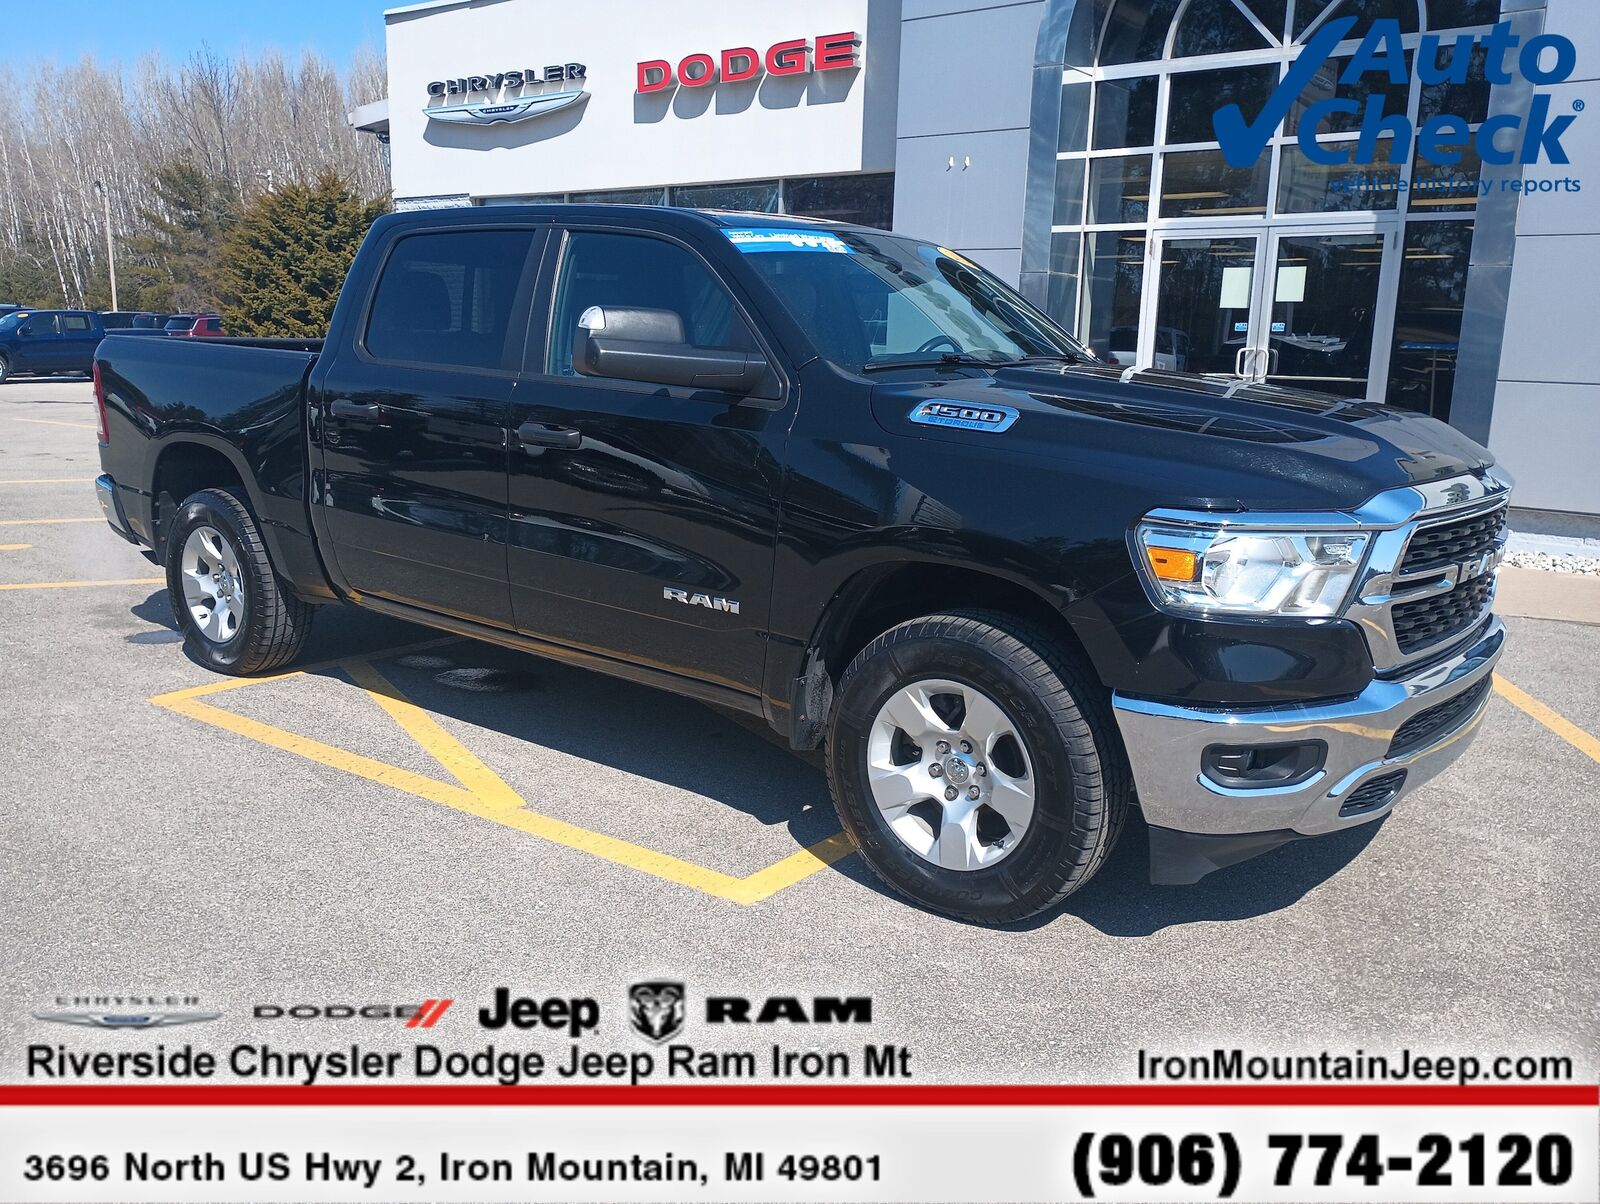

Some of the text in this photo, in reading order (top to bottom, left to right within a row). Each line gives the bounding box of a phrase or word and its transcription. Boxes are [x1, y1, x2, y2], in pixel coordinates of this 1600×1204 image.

[636, 31, 860, 95] DODGE
[427, 62, 586, 97] CHRYSLER
[918, 403, 1002, 423] 1500
[663, 586, 740, 615] RAM
